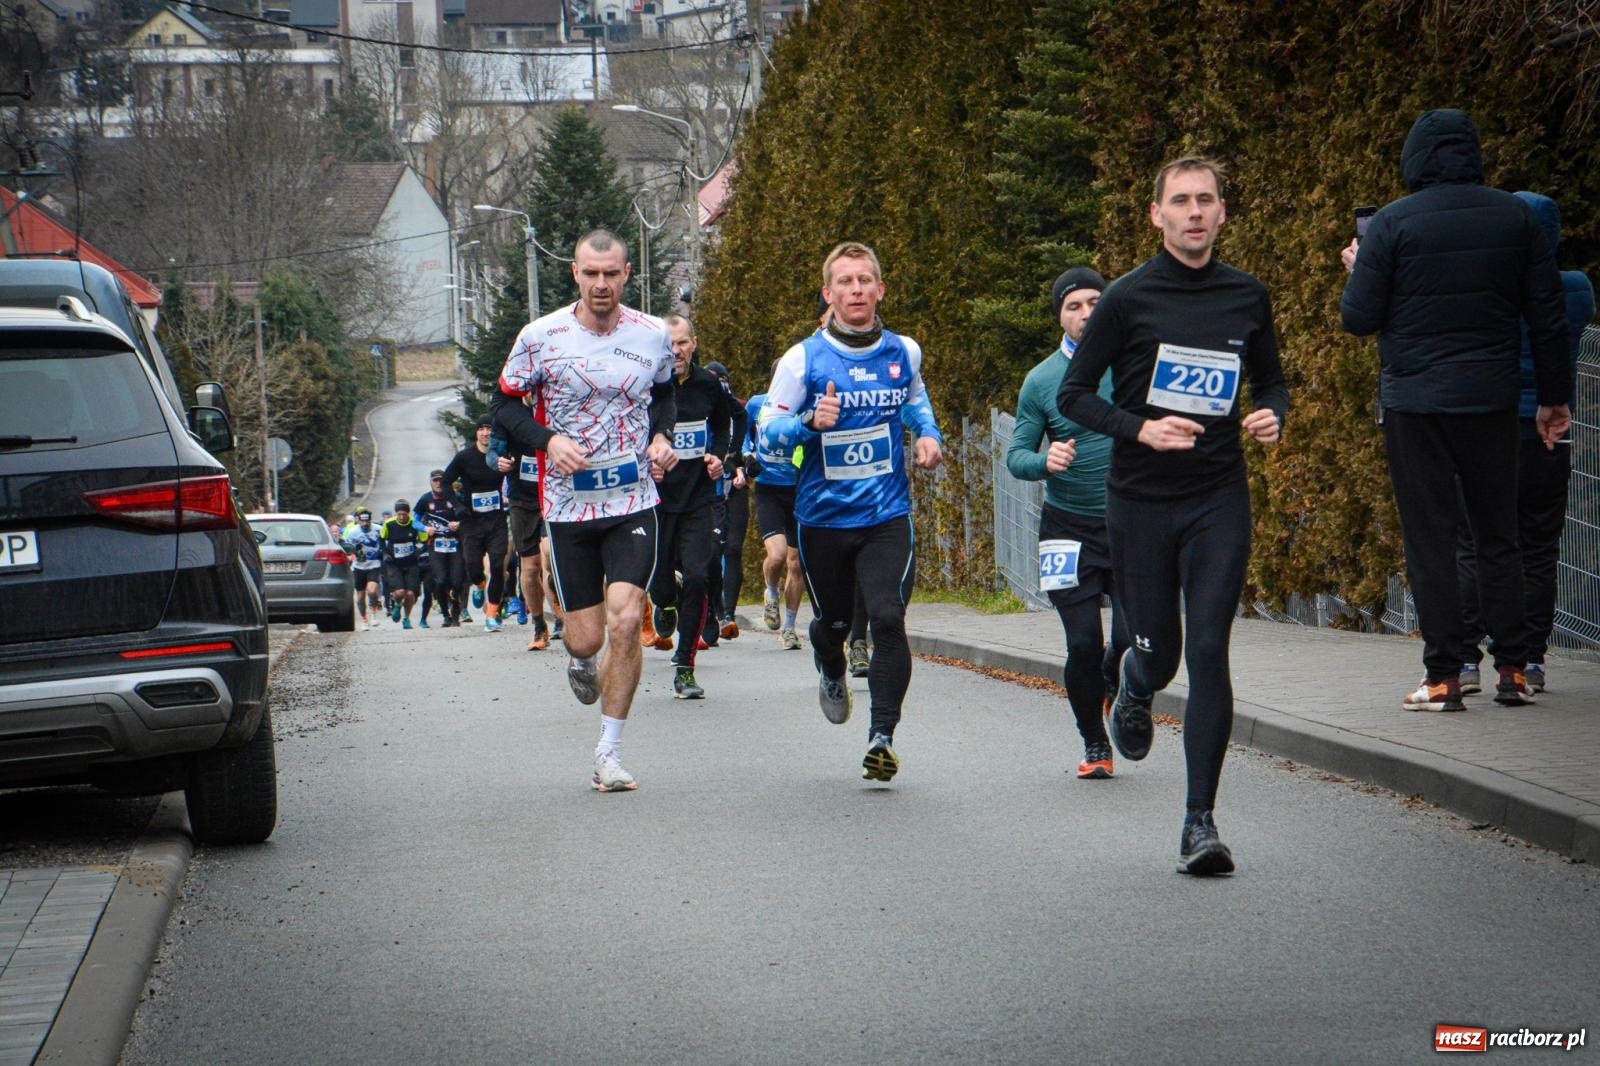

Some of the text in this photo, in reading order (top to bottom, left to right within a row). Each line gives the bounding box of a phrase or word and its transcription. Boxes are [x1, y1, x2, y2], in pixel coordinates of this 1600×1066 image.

[547, 325, 570, 337] deep
[613, 347, 653, 368] DYCZUS
[1166, 365, 1224, 396] 220
[674, 433, 696, 448] 83
[844, 442, 874, 465] 60
[592, 467, 621, 489] 15
[480, 498, 493, 506] 93
[1041, 553, 1067, 574] 49
